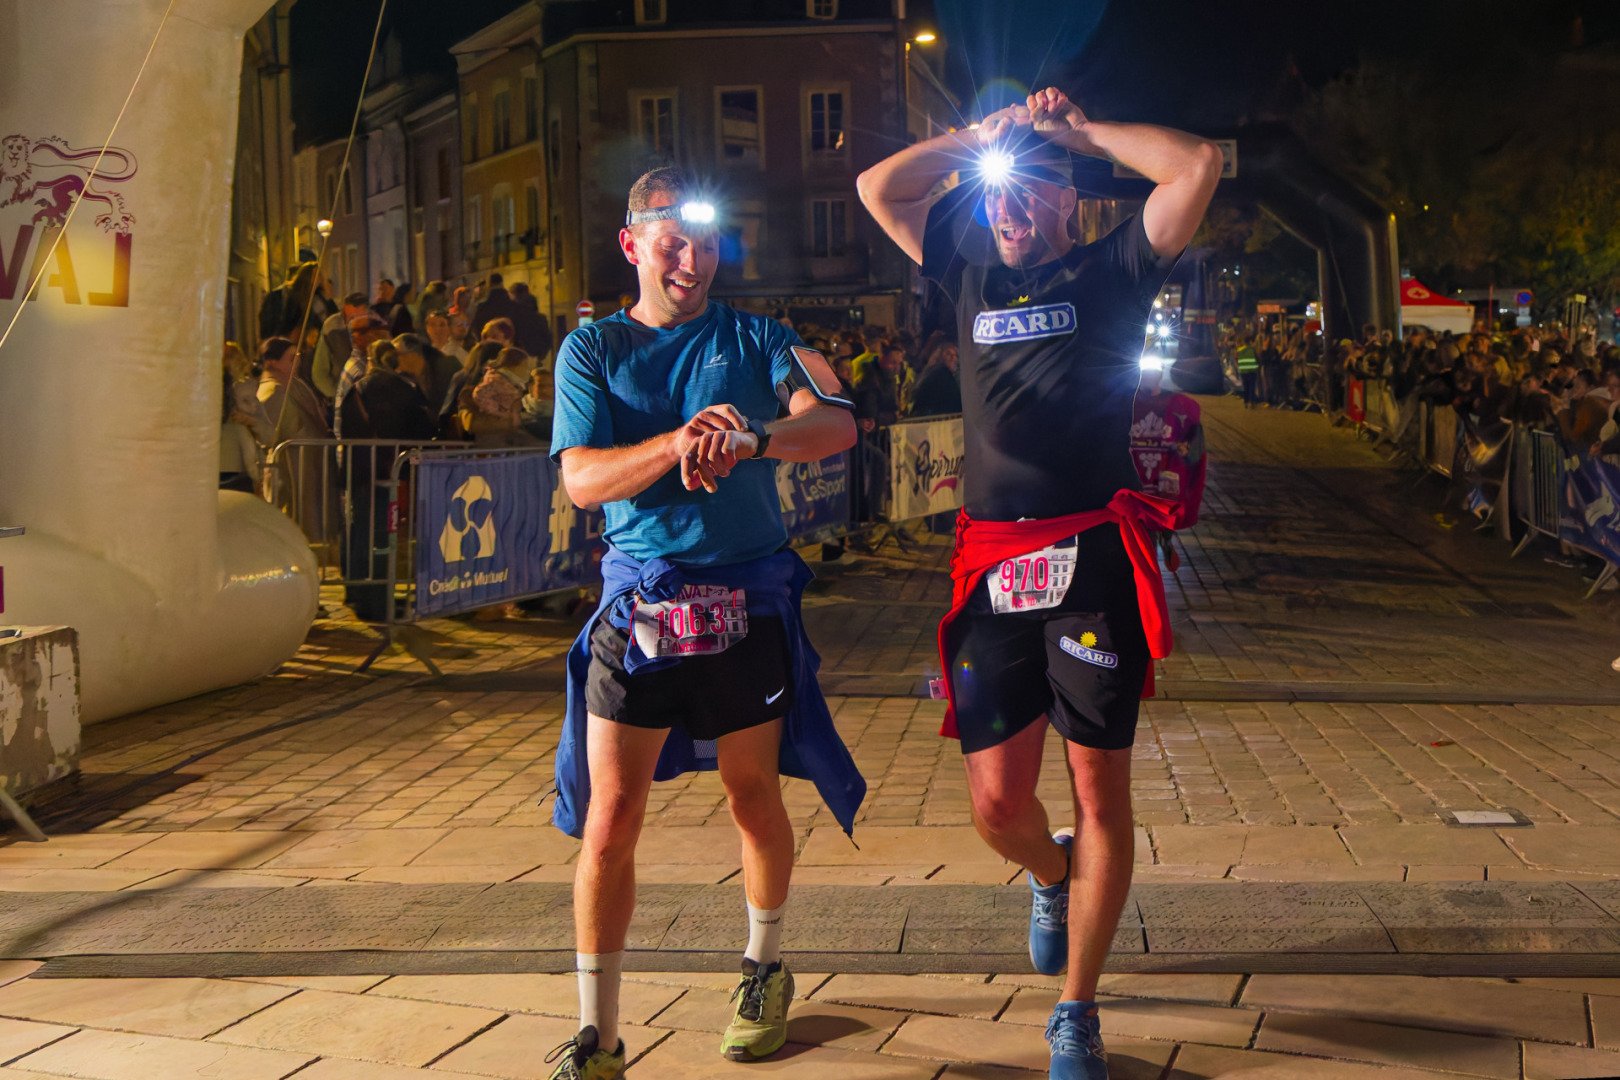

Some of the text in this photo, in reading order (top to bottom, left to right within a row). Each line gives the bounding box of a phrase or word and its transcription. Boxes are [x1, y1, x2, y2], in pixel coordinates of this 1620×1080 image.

[976, 310, 1070, 338] RCARD
[1001, 556, 1049, 593] 970
[655, 602, 727, 640] 1063
[1063, 640, 1115, 665] RICARD
